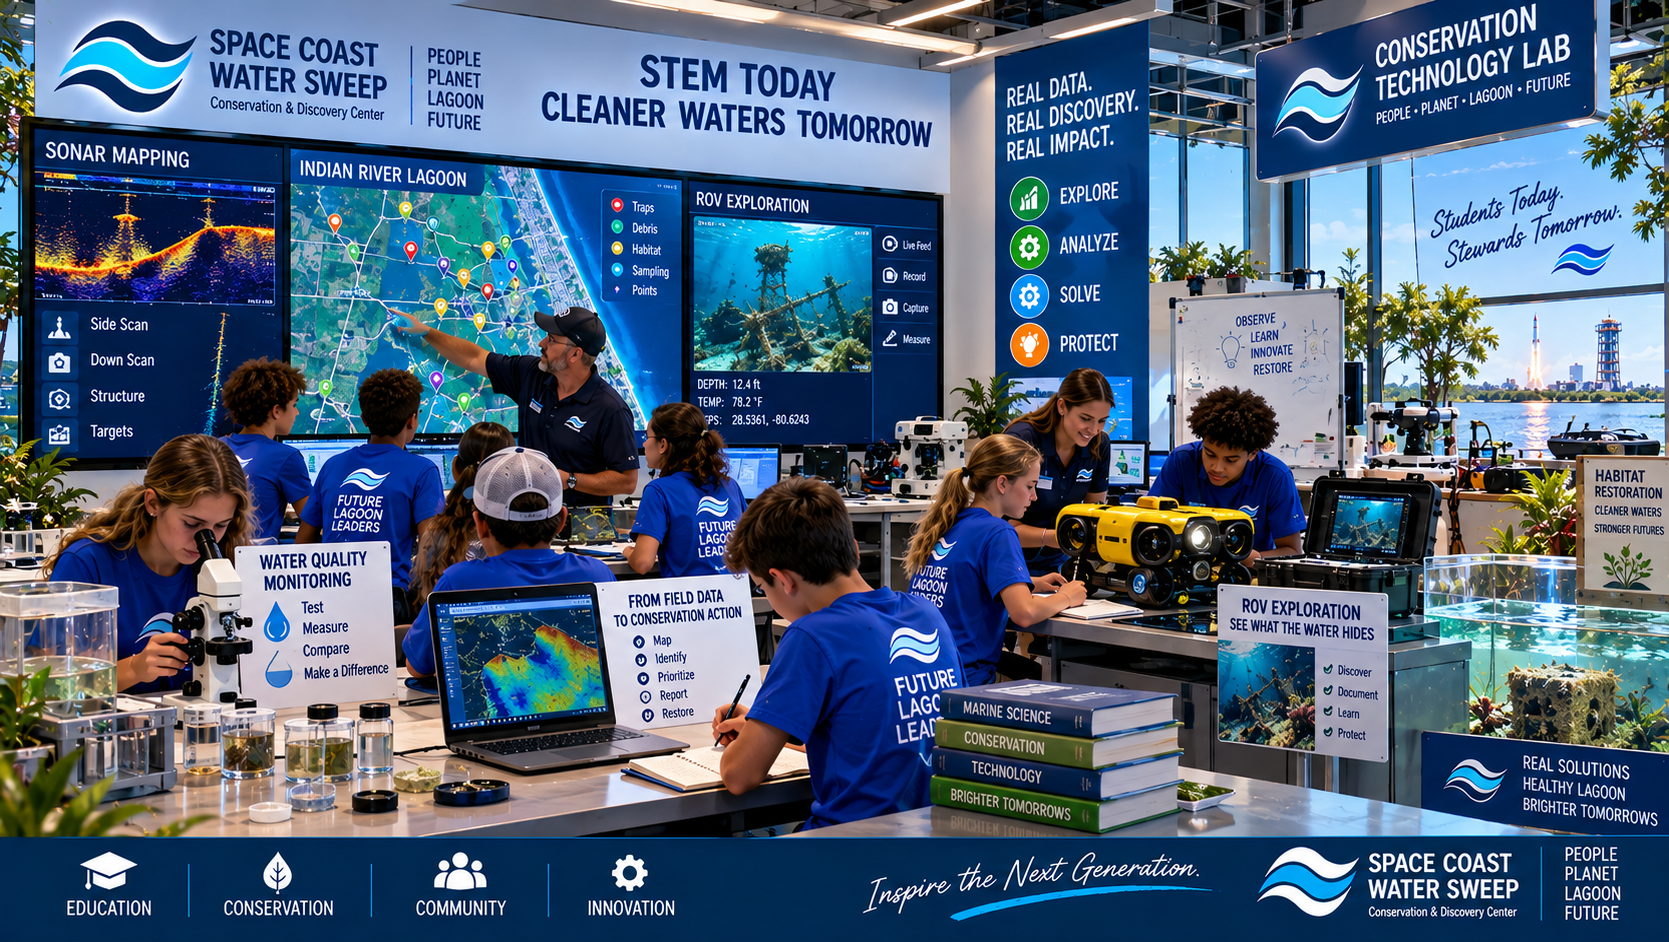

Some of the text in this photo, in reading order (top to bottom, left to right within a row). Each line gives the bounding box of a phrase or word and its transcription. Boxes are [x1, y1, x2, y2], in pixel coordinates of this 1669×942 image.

[1374, 3, 1537, 68] CONSERVATION
[210, 29, 379, 67] SPACE COAST
[428, 47, 481, 68] PEOPLE
[1375, 34, 1570, 101] TECHNOLOGY LAB
[209, 61, 387, 99] WATER SWEEP
[428, 68, 481, 89] PLANET
[640, 54, 836, 102] STEM TODAY
[1006, 70, 1093, 108] REAL DATA.
[428, 90, 484, 110] LAGOON
[1376, 72, 1571, 125] PEOPLE PLANET LAGOON FUTURE
[210, 96, 385, 121] Conservation & Discovery Center
[1007, 89, 1138, 135] REAL DISCOVERY.
[428, 111, 481, 131] FUTURE
[542, 91, 932, 147] CLEANER WATERS TOMORROW
[1007, 124, 1114, 162] REAL IMPACT.
[46, 141, 189, 168] SONAR MAPPING
[300, 160, 466, 187] INDIAN RIVER LAGOON
[1060, 181, 1119, 204] EXPLORE
[632, 201, 655, 215] Traps
[696, 191, 809, 214] ROV EXPLORATION
[1430, 180, 1564, 239] Students Today.
[632, 222, 658, 234] Debris
[632, 243, 661, 256] Habitat
[903, 240, 931, 251] Live Feed
[1060, 232, 1119, 254] ANALYZE
[1444, 223, 1527, 269] Stewards
[632, 264, 669, 280] Sampling
[903, 271, 926, 282] Record
[632, 284, 657, 296] Points
[1060, 284, 1100, 303] SOLVE
[903, 302, 929, 315] Capture
[90, 317, 148, 331] Side Scan
[1236, 312, 1276, 327] OBSERVE
[903, 334, 931, 344] Measure
[1060, 333, 1119, 352] PROTECT
[1251, 329, 1279, 343] LEARN
[1251, 344, 1293, 359] INNOVATE
[90, 353, 155, 367] Down Scan
[1253, 361, 1293, 375] RESTORE
[697, 378, 761, 390] DEPTH: 12.4 ft
[90, 389, 145, 403] Structure
[698, 396, 724, 407] TEMP:
[732, 396, 751, 407] 78.2
[732, 414, 769, 426] 28.5361,
[772, 414, 809, 425] -80.6243
[90, 424, 133, 441] Targets
[1595, 469, 1645, 483] HABITAT
[1595, 485, 1662, 499] RESTORATION
[337, 494, 383, 507] FUTURE
[334, 507, 383, 520] LAGOON
[1595, 505, 1662, 517] CLEANER WATERS
[331, 520, 380, 533] LEADERS
[698, 520, 737, 533] FUTURE
[1594, 523, 1665, 536] STRONGER FUTURES
[698, 545, 729, 558] LEAD
[259, 551, 367, 570] WATER QUALITY
[920, 565, 948, 580] UTURE
[264, 571, 351, 591] MONITORING
[912, 578, 948, 594] LAGOON
[628, 589, 724, 608] FROM FIELD DATA
[301, 601, 324, 614] Test
[1242, 598, 1360, 621] ROV EXPLORATION
[613, 606, 742, 627] TO CONSERVATION ACTION
[303, 622, 349, 635] Measure
[1229, 617, 1374, 641] SEE WHAT THE WATER HIDES
[653, 635, 672, 647] Map
[303, 644, 350, 659] Compare
[655, 651, 687, 664] Identify
[304, 663, 389, 680] Make a Difference
[658, 670, 695, 683] Prioritize
[1338, 664, 1372, 677] Discover
[894, 668, 958, 697] FUTURE
[660, 689, 688, 702] Report
[1338, 686, 1378, 700] Document
[662, 708, 694, 719] Restore
[898, 693, 940, 720] LAGO
[963, 701, 1051, 725] MARINE SCIENCE
[1338, 707, 1360, 719] Learn
[896, 716, 944, 744] LEAD
[1338, 727, 1366, 741] Protect
[964, 731, 1045, 756] CONSERVATION
[971, 760, 1042, 784] TECHNOLOGY
[1523, 755, 1630, 780] REAL SOLUTIONS
[1523, 776, 1625, 801] HEALTHY LAGOON
[951, 788, 1071, 821] BRIGHTER TOMORROWS
[1523, 797, 1658, 827] BRIGHTER TOMORROWS
